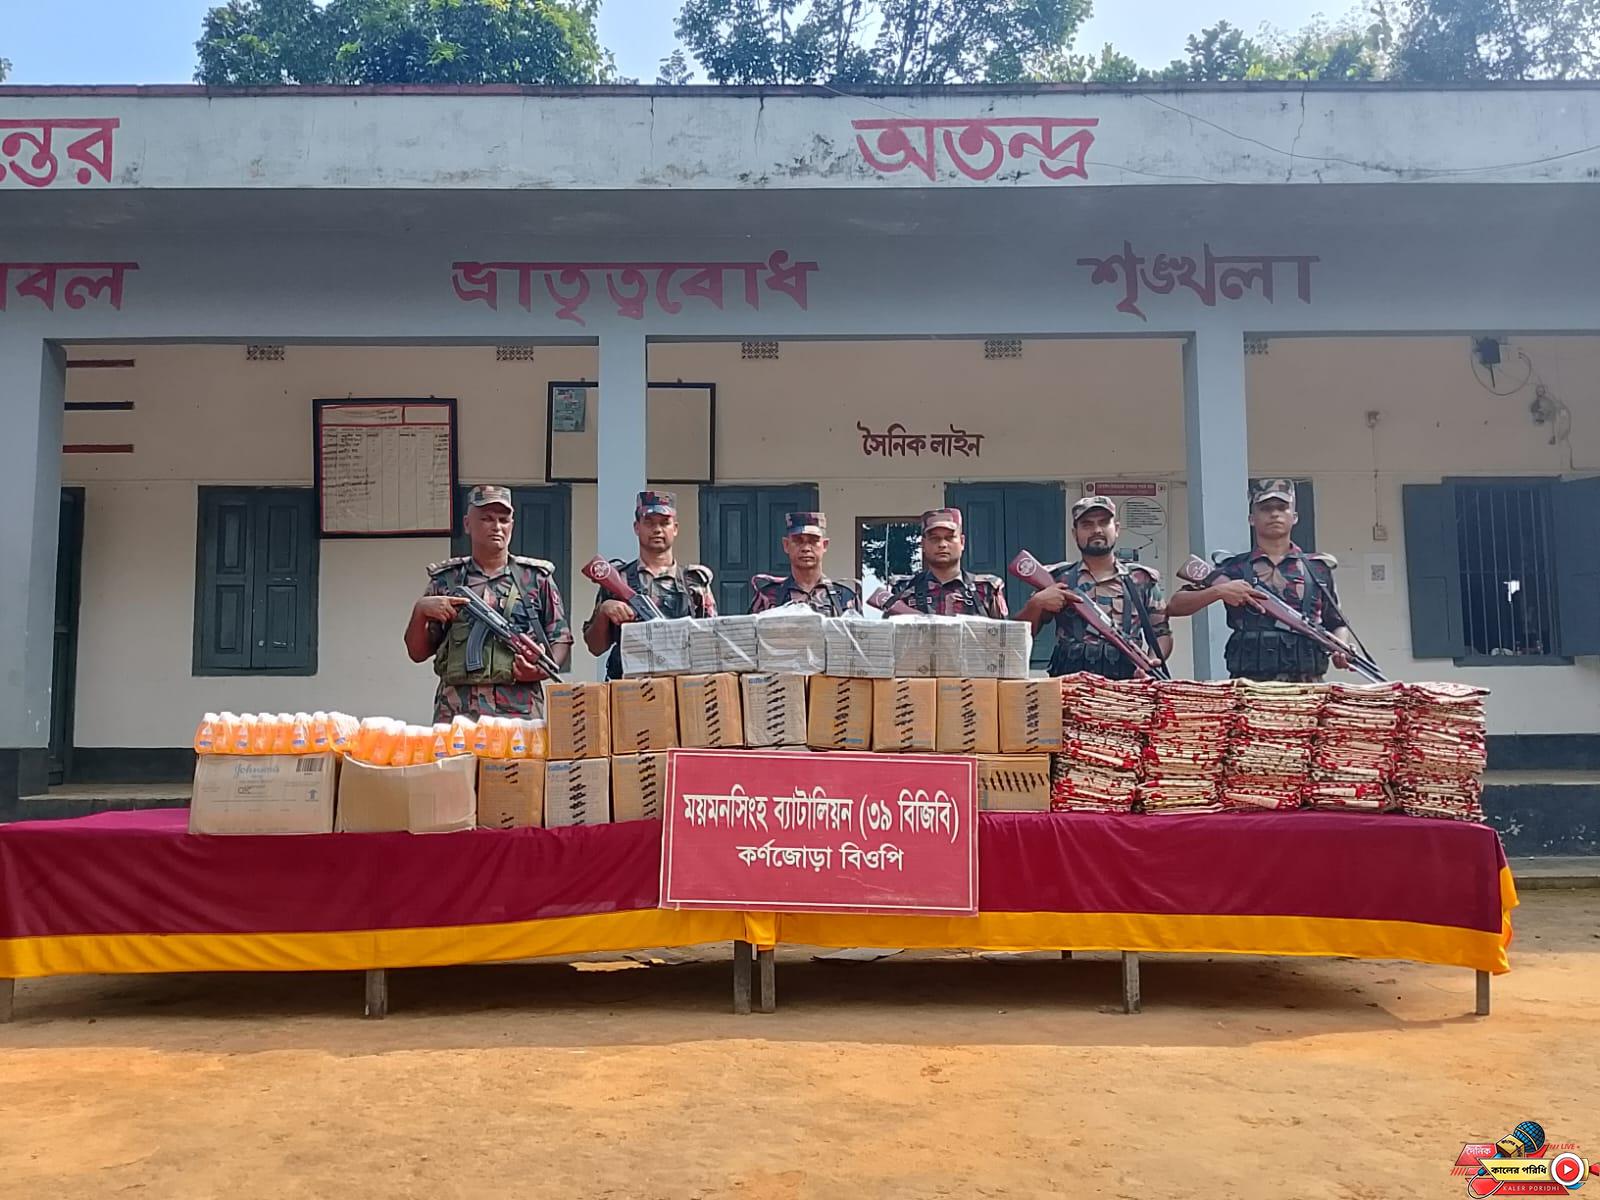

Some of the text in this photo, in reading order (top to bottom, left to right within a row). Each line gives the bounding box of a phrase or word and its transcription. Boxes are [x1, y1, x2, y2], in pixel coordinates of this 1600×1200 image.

[851, 117, 1099, 181] অতন্দ্র
[452, 250, 820, 327] ভ্রাতৃত্ববোধ
[1077, 240, 1320, 322] শৃঙ্খলা
[857, 421, 985, 457] সৈনিক লাইন
[683, 784, 769, 833] ময়মনসিংহ
[773, 786, 853, 832] ব্যাটালিয়ন
[859, 794, 893, 841] (৩৯
[897, 788, 959, 843] বিজিবি)
[736, 839, 904, 872] কর্ণজোড়া বিওপি
